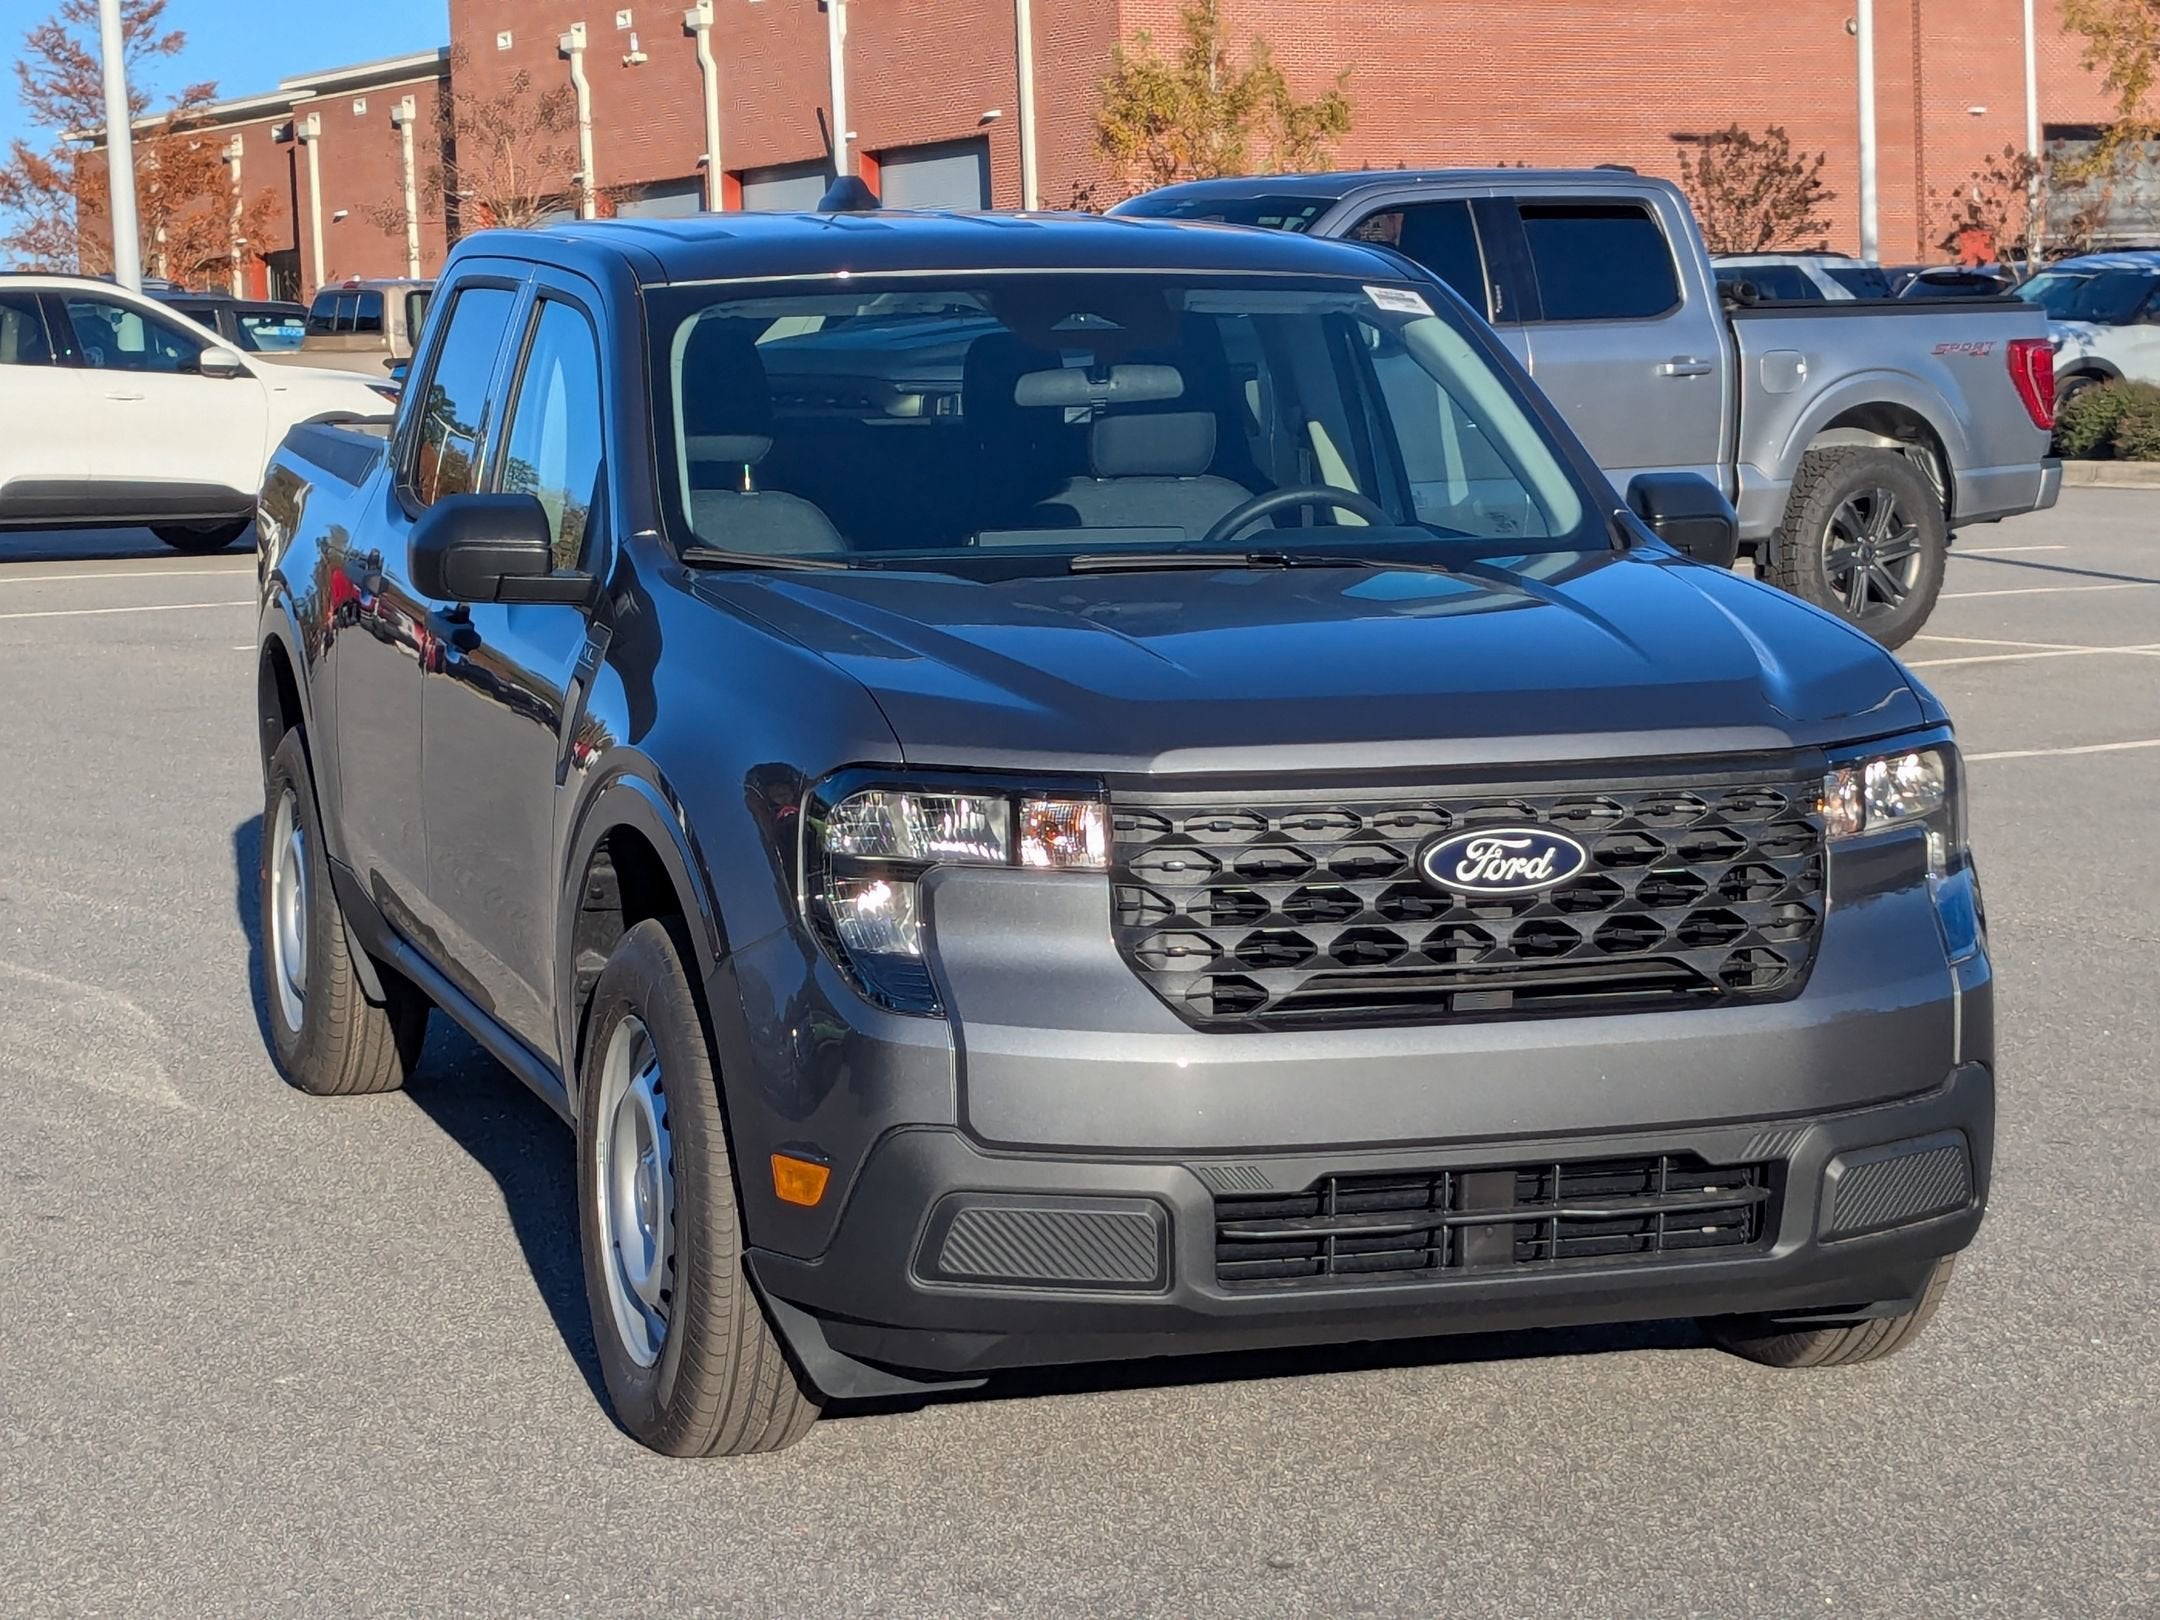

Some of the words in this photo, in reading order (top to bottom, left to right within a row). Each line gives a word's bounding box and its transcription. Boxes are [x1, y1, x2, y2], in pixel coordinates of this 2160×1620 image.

[1930, 341, 1997, 356] SPORT
[580, 643, 594, 663] XL
[1456, 838, 1557, 882] Ford
